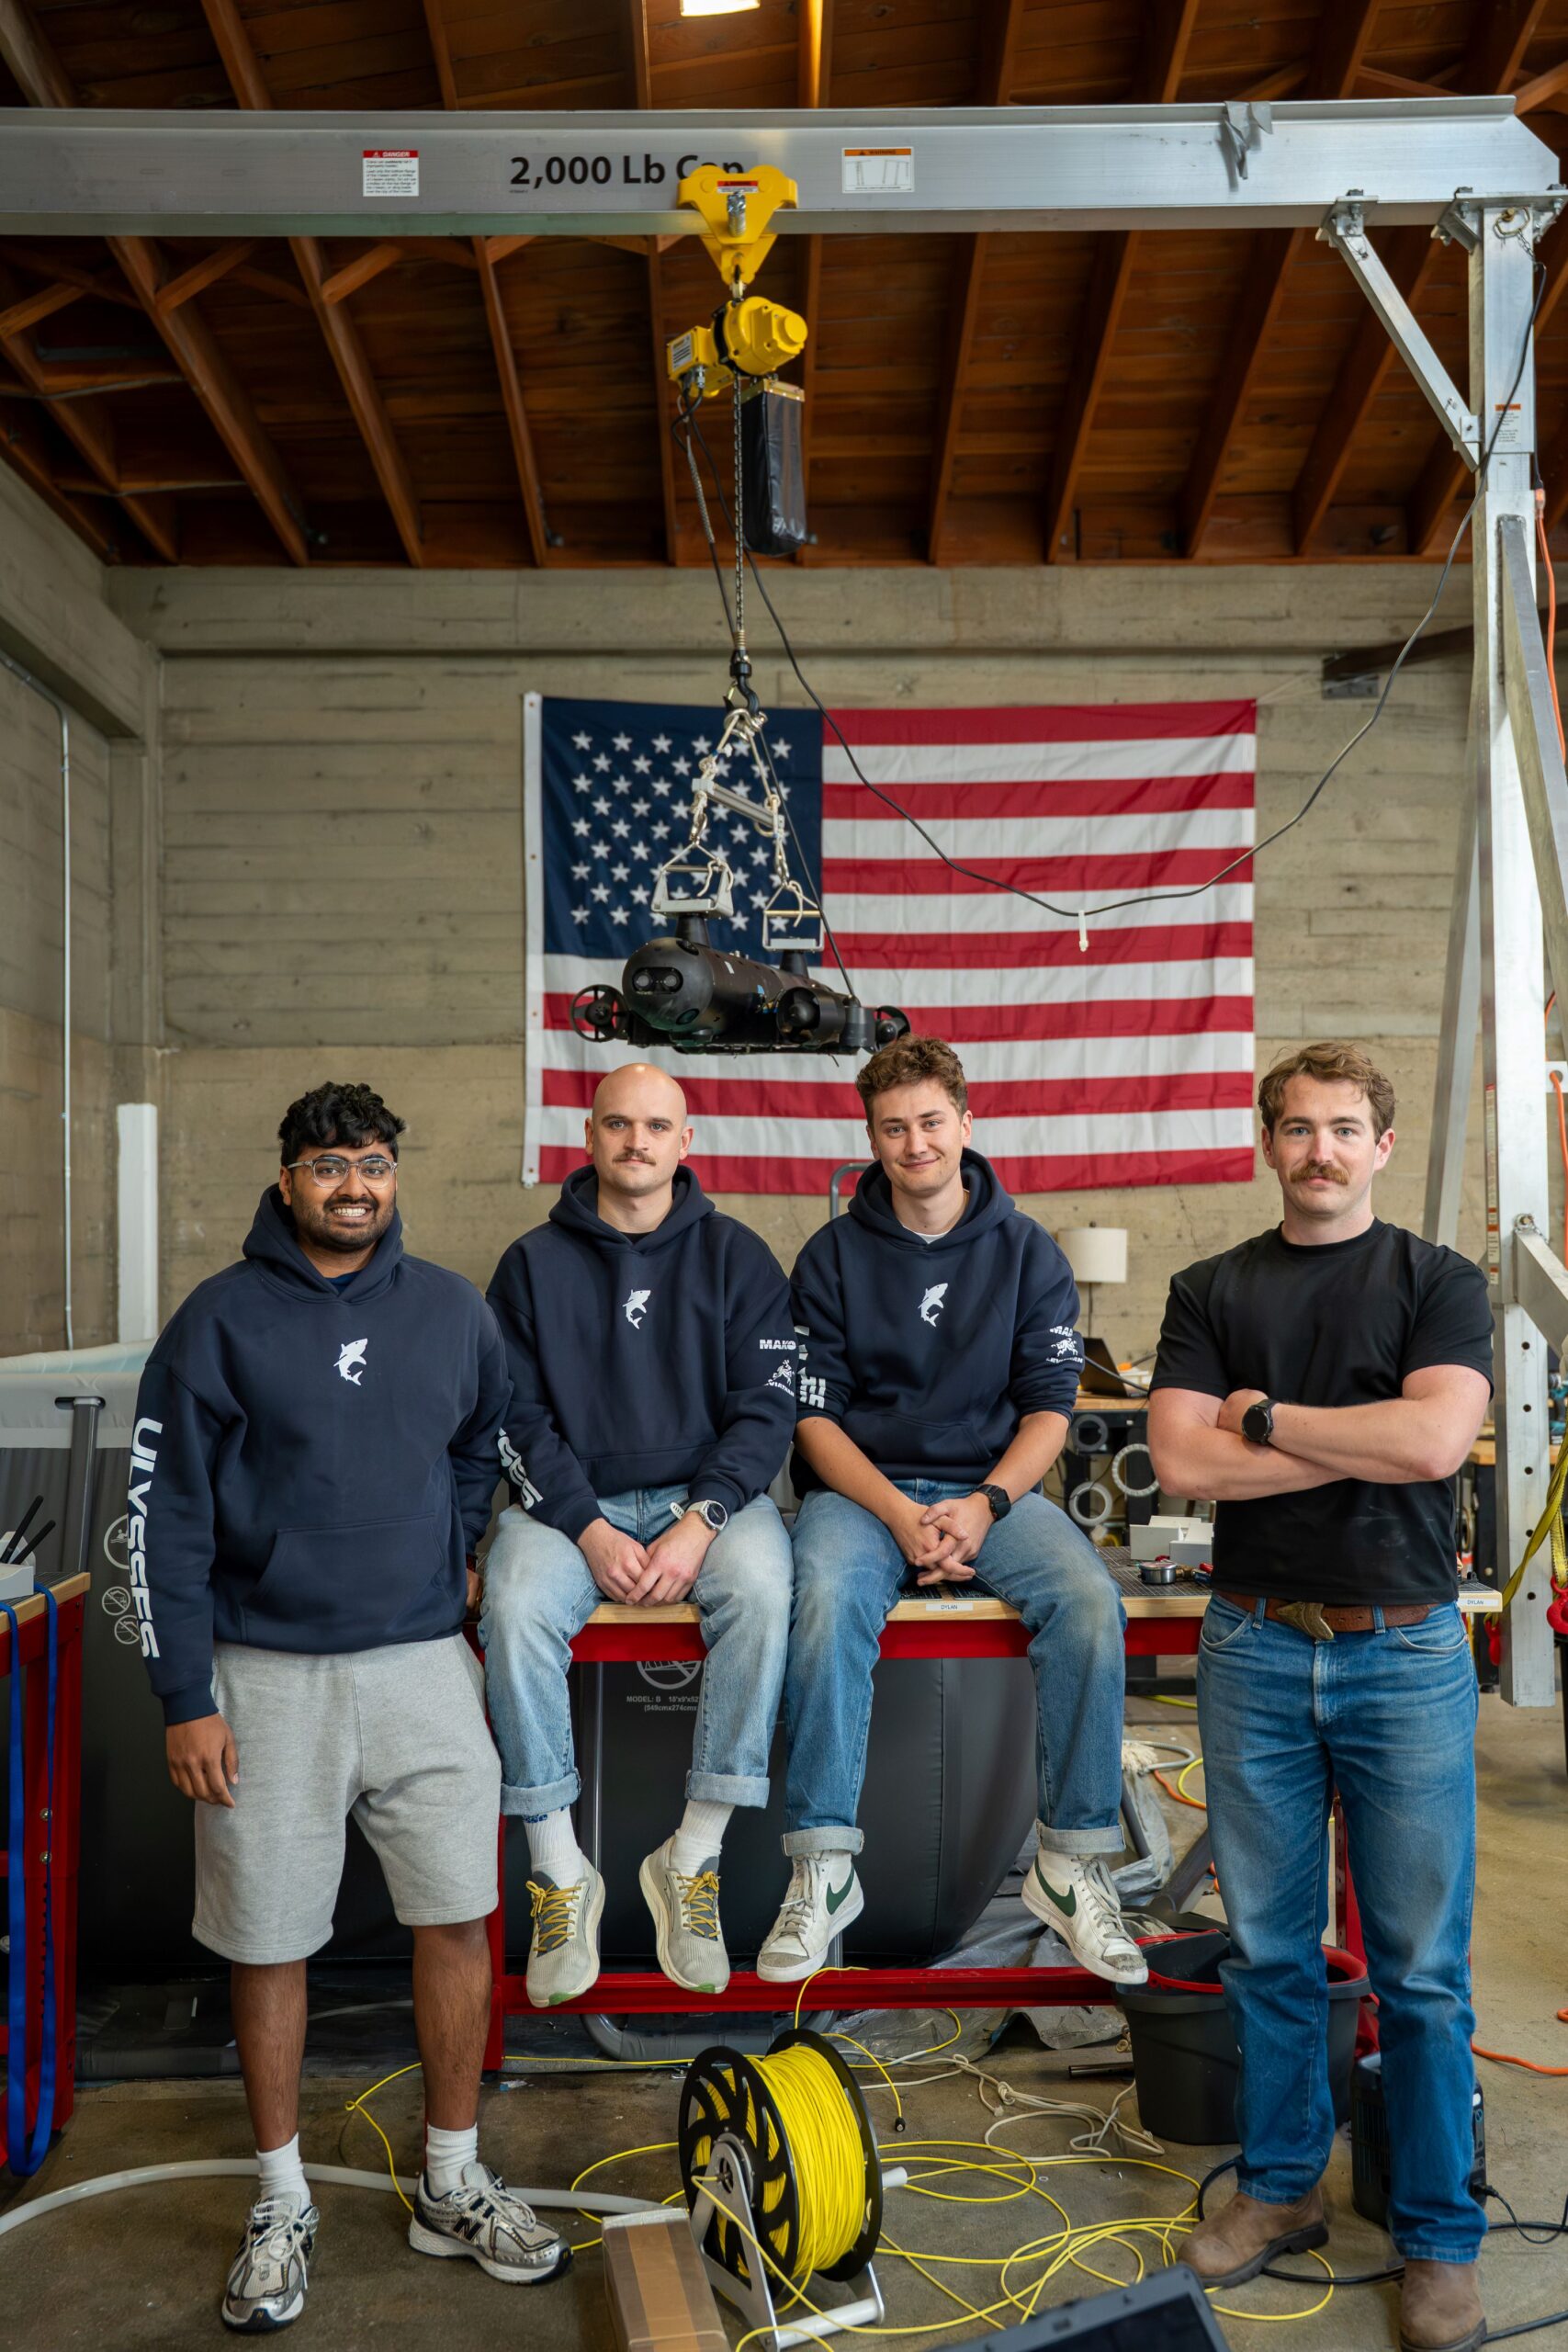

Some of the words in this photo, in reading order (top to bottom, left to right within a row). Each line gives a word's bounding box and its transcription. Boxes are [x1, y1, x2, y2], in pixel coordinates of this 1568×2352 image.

[510, 156, 612, 189] 2,000
[623, 154, 666, 185] Lb
[759, 1339, 797, 1351] MAKO
[128, 1417, 164, 1658] ULYSSES
